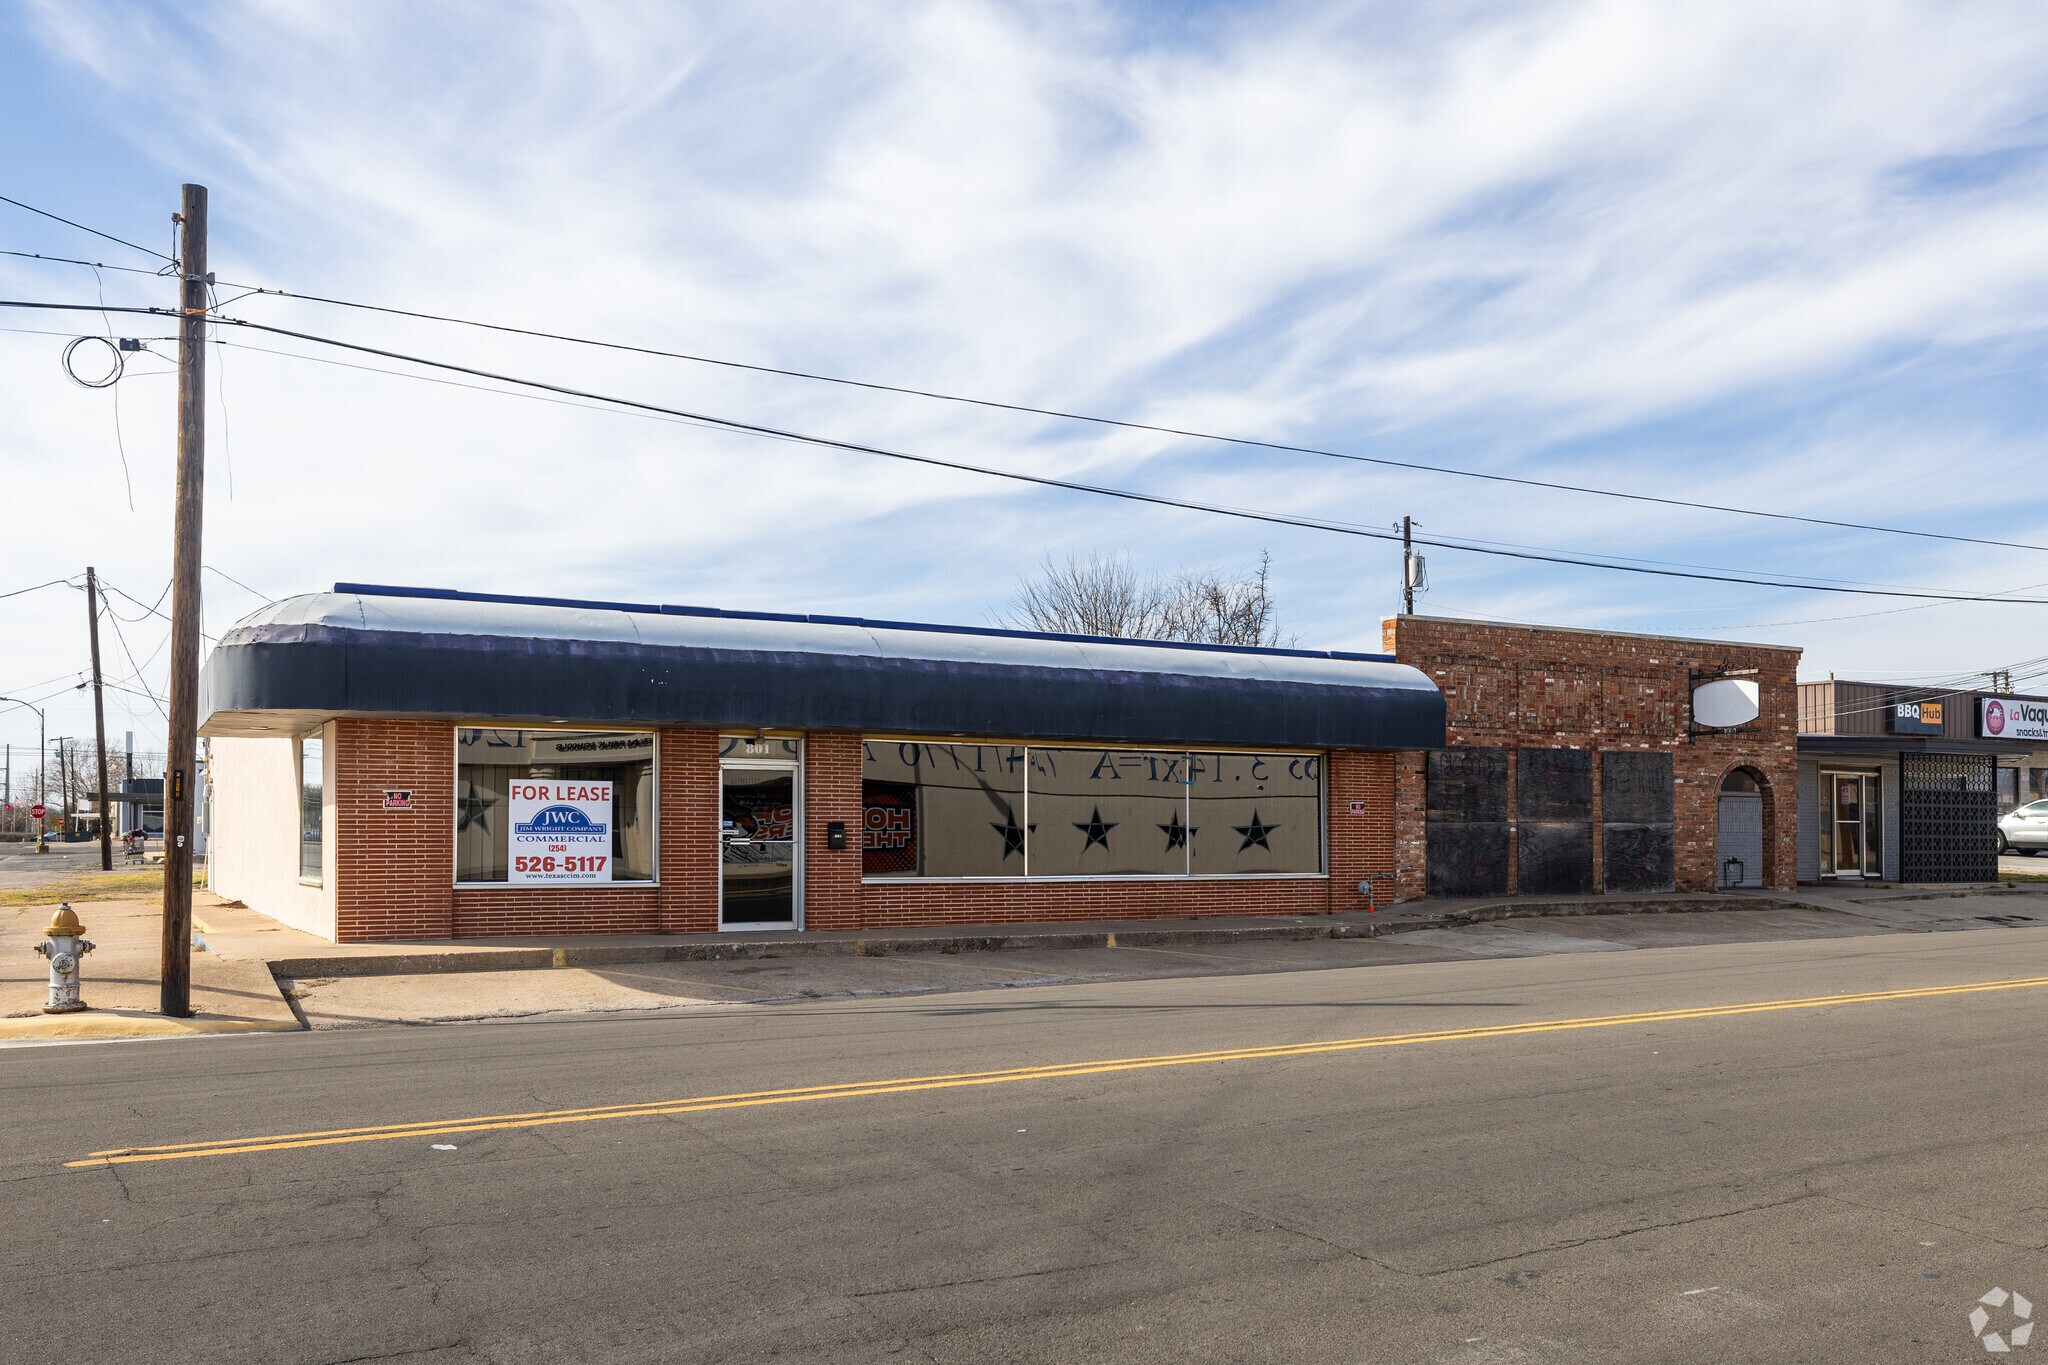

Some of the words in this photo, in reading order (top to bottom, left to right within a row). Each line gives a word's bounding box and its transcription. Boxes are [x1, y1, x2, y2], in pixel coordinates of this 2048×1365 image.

[1897, 704, 1920, 720] BBQ
[1922, 707, 1941, 719] Hub
[745, 743, 770, 755] 801
[511, 785, 550, 801] FOR
[556, 786, 610, 802] LEASE
[386, 799, 411, 807] PARKING
[542, 811, 580, 825] JWC
[516, 835, 606, 843] COMMERCIAL
[548, 844, 567, 852] (254)
[515, 856, 607, 872] 526-5117
